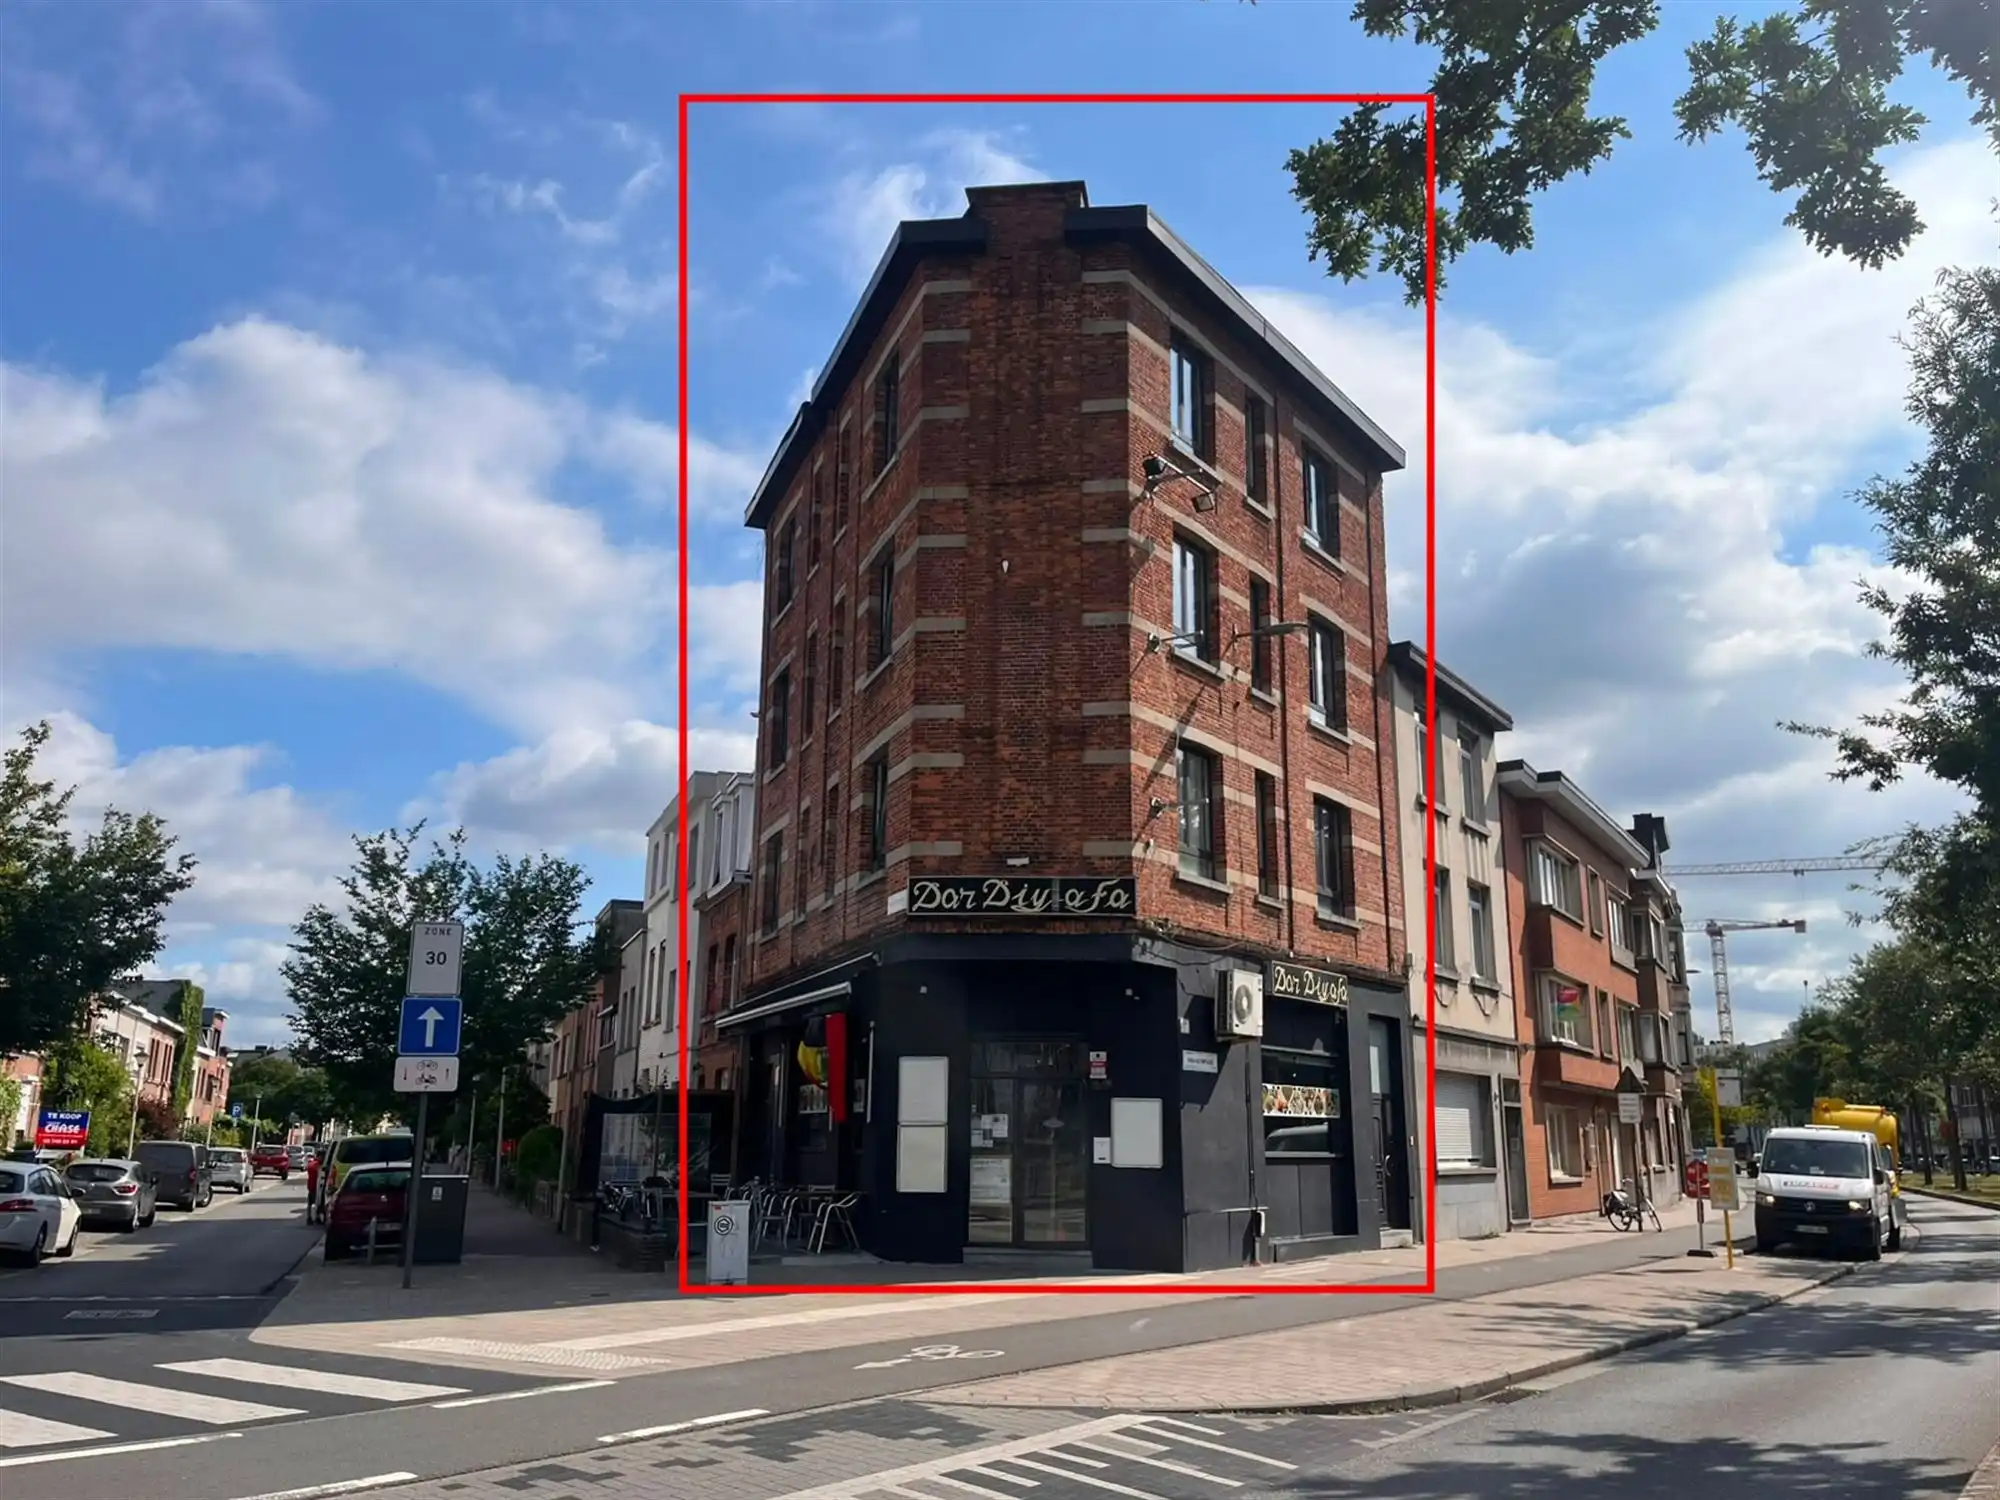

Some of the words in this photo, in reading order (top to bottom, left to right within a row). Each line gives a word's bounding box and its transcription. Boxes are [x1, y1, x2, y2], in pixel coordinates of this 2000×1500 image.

[424, 927, 452, 936] ZONE
[425, 951, 447, 966] 30
[232, 1105, 241, 1117] P
